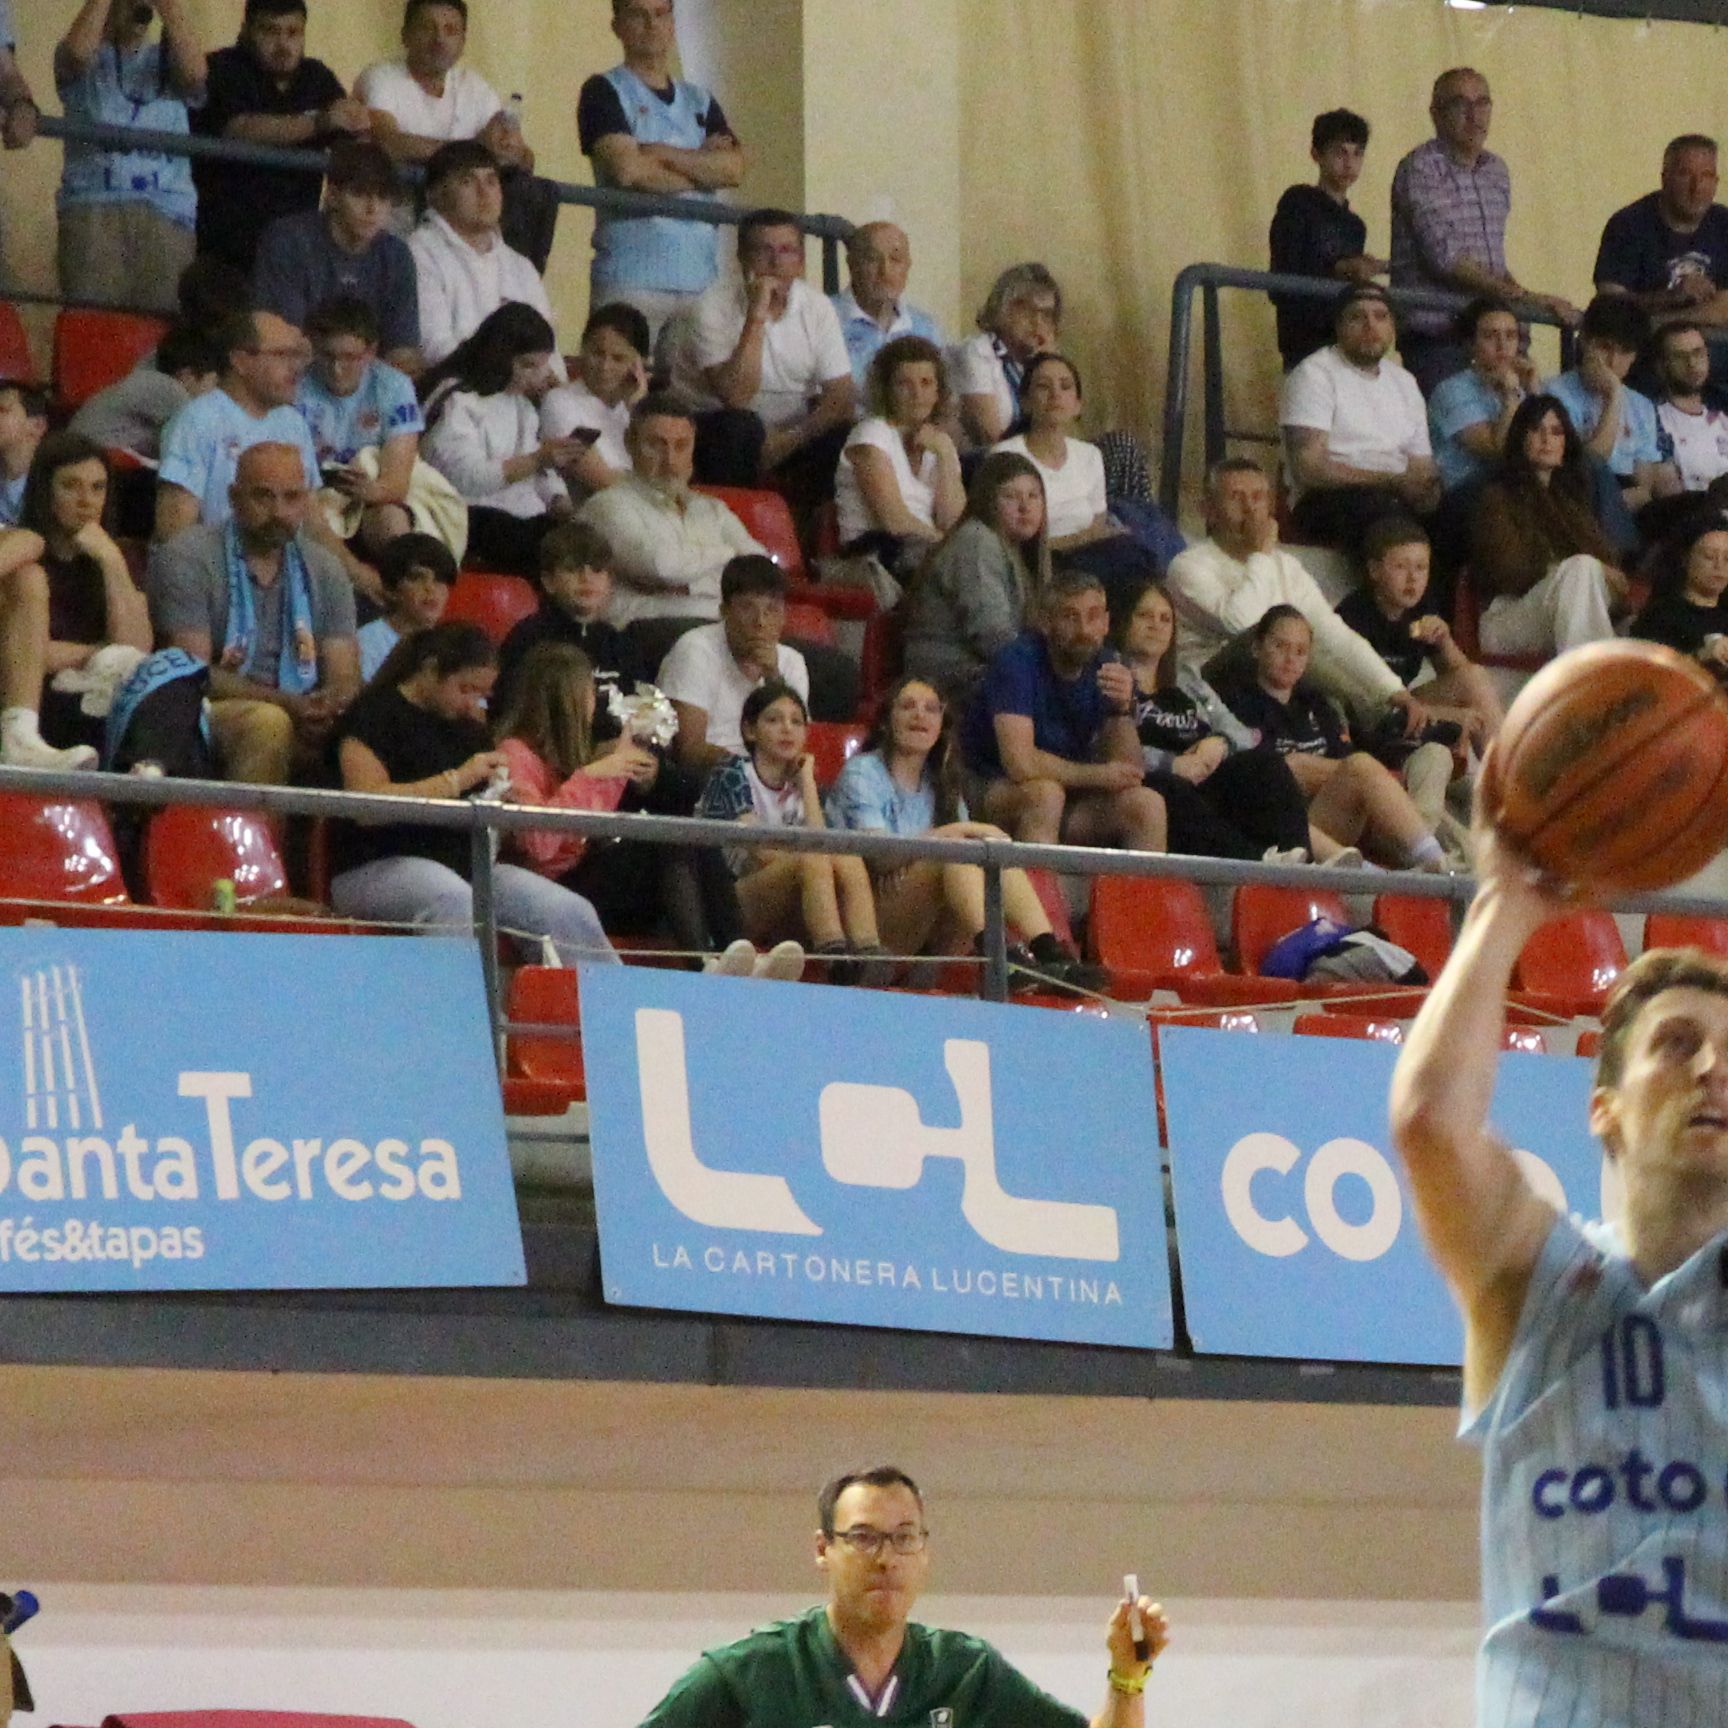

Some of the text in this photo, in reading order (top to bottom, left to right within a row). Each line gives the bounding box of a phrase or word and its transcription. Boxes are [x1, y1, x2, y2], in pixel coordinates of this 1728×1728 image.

[0, 1070, 463, 1201] antaTeresa
[652, 1243, 1123, 1305] LA CARTONERA LUCENTINA
[1602, 1312, 1665, 1410] 10
[1532, 1447, 1705, 1521] coto
